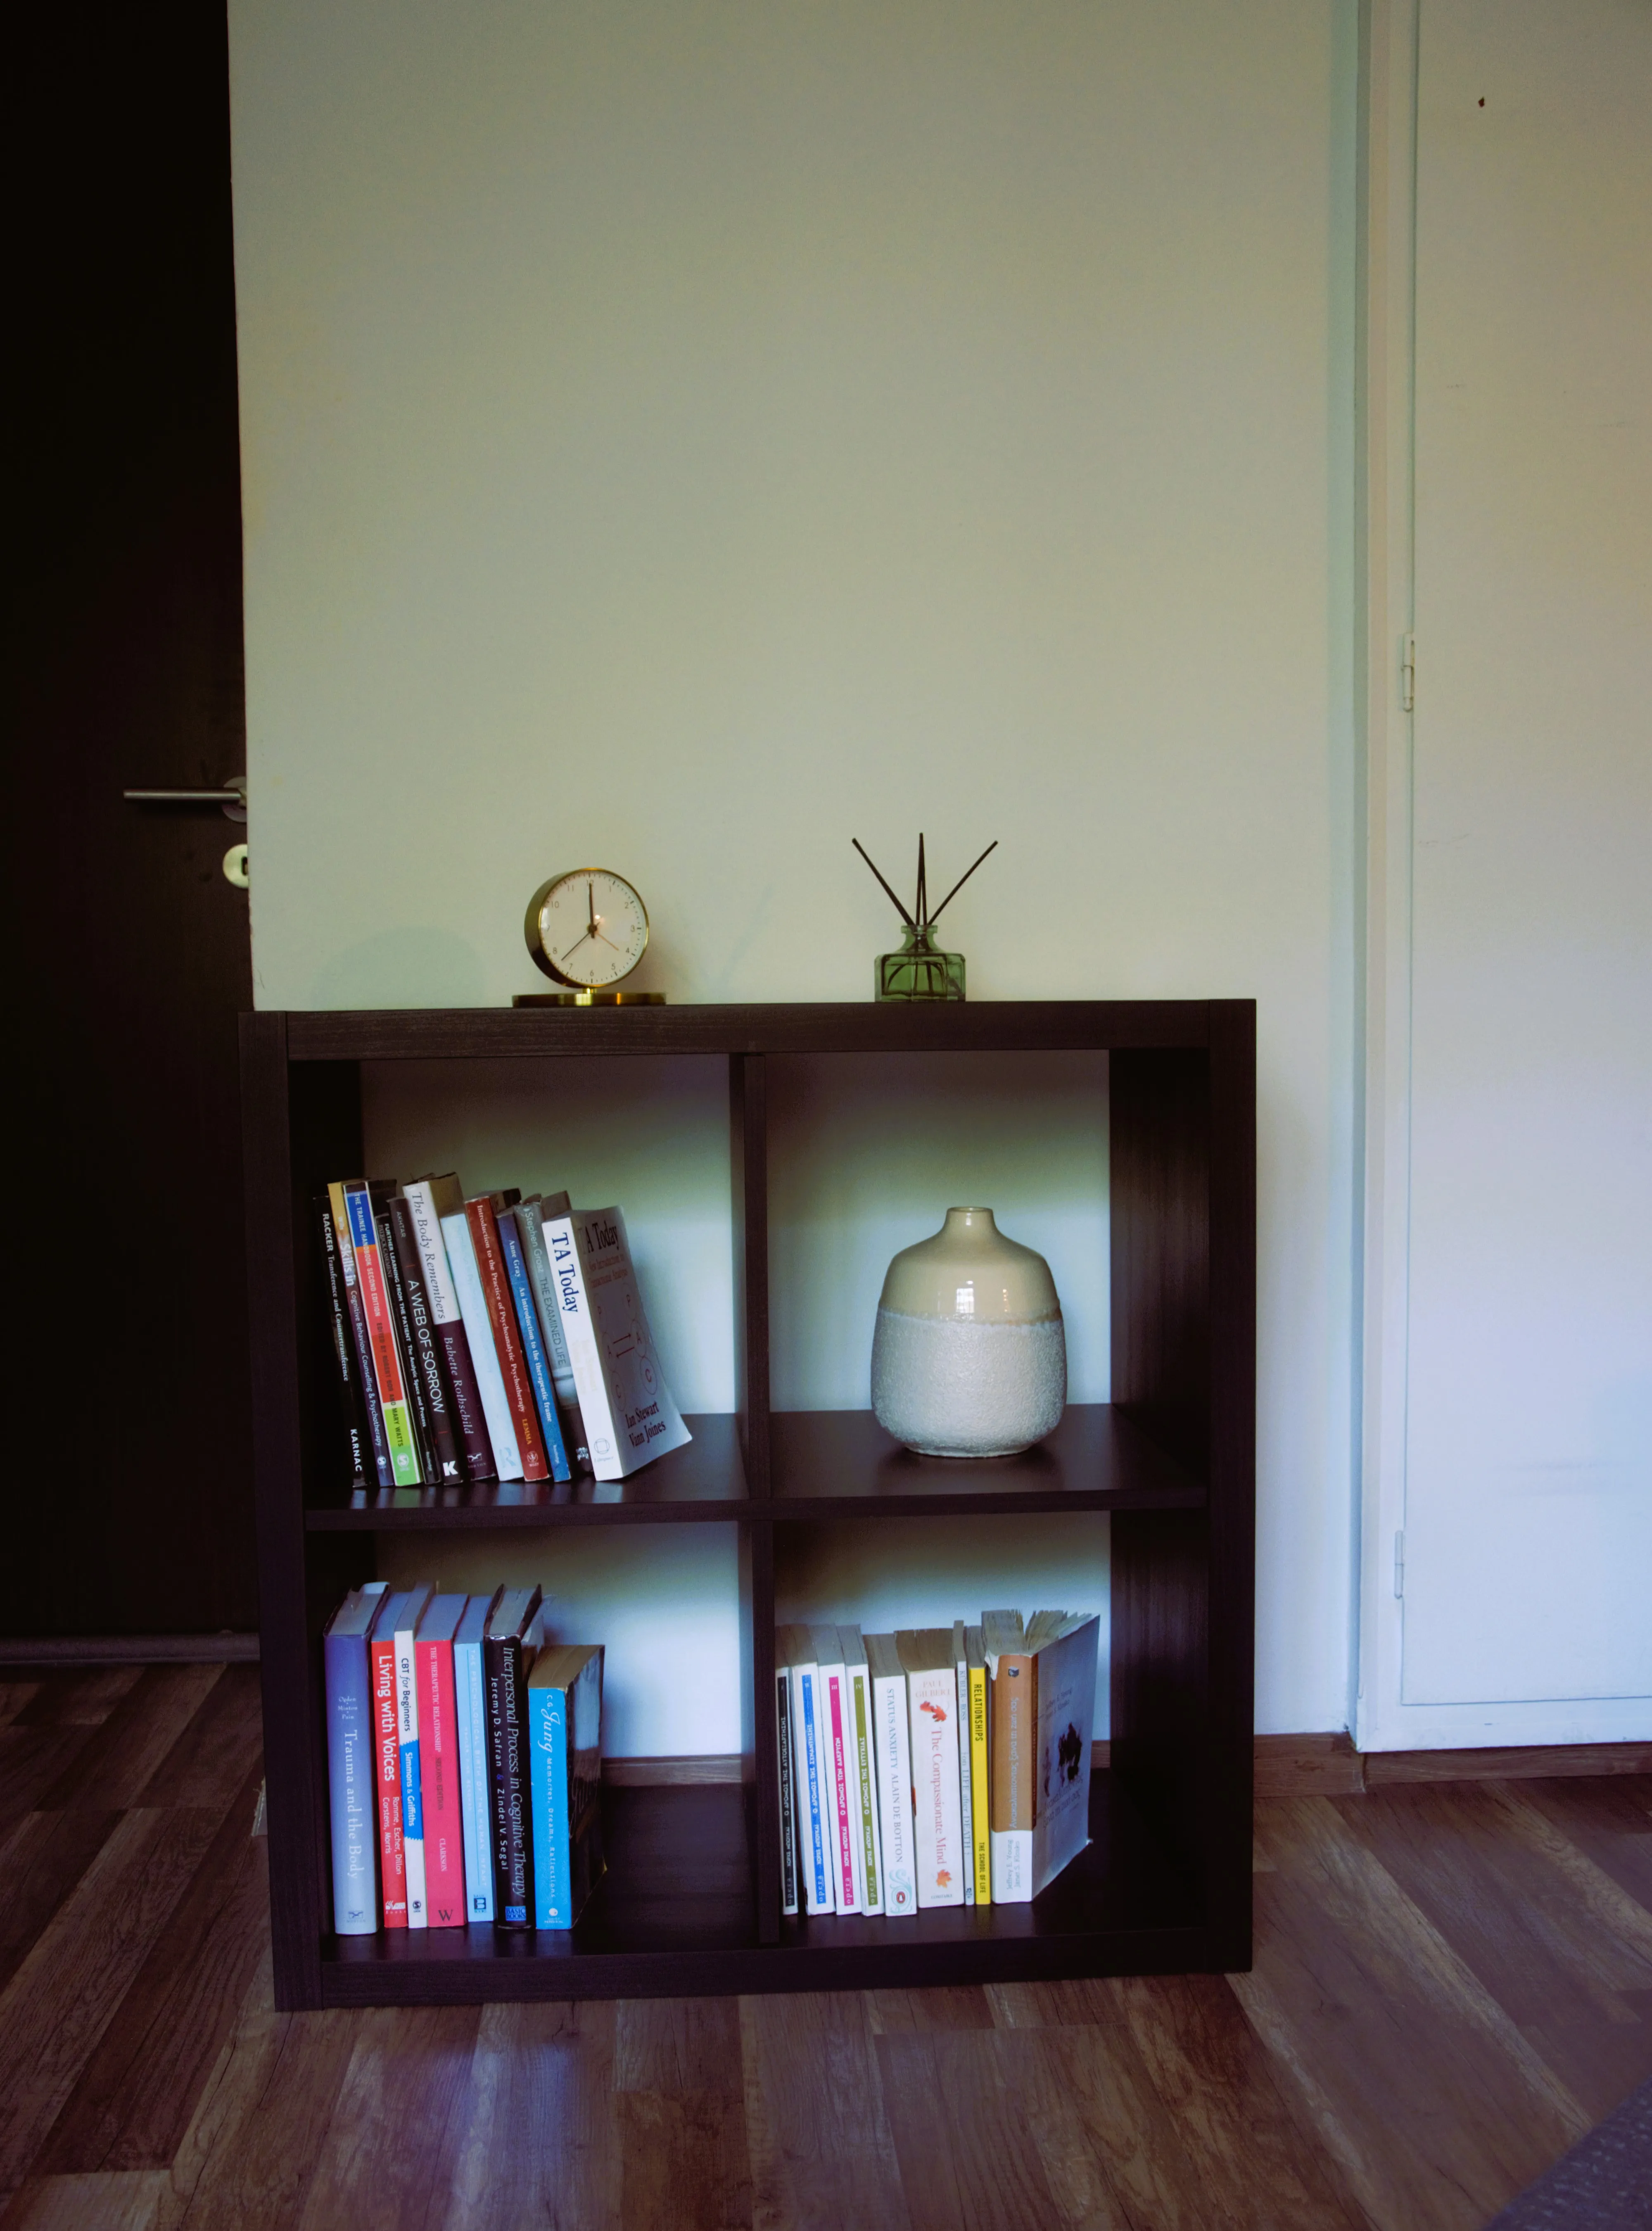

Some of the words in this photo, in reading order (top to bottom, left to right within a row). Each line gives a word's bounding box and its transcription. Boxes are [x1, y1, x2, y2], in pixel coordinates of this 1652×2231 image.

[411, 1192, 424, 1214] The
[356, 1207, 366, 1232] TRAINEE
[396, 1211, 406, 1238] AKHTAR
[417, 1219, 432, 1248] Body
[477, 1205, 491, 1249] Introduction
[591, 1220, 619, 1251] Today
[361, 1233, 372, 1266] HANDBOOK
[385, 1223, 394, 1251] FURTHER
[525, 1211, 538, 1247] Stephen
[534, 1248, 544, 1273] Grosz
[340, 1243, 355, 1273] Skills
[389, 1252, 400, 1283] LEARNING
[487, 1250, 492, 1258] to
[509, 1240, 517, 1258] Anne
[513, 1259, 521, 1278] Gray
[346, 1274, 356, 1286] in
[366, 1267, 376, 1292] SECOND
[408, 1281, 420, 1290] A
[425, 1253, 445, 1319] Remembers
[491, 1272, 501, 1301] Practice
[519, 1287, 525, 1297] An
[539, 1277, 551, 1295] THE
[558, 1264, 579, 1313] Today
[323, 1214, 333, 1251] RACKER
[328, 1255, 337, 1297] Transference
[336, 1314, 349, 1381] Countertransference
[350, 1290, 360, 1321] Cognitive
[371, 1293, 381, 1316] EDITION
[412, 1292, 427, 1326] WEB
[498, 1302, 505, 1311] of
[401, 1316, 411, 1342] PATIENT
[521, 1298, 534, 1340] introduction
[544, 1297, 561, 1345] EXAMINED
[356, 1322, 366, 1354] Behaviour
[418, 1328, 432, 1347] OF
[499, 1312, 516, 1362] Psychoanalytic
[555, 1346, 566, 1365] LIFE
[362, 1355, 373, 1392] Counselling
[376, 1322, 385, 1343] EDITED
[381, 1345, 386, 1353] BY
[395, 1426, 404, 1447] WATTS
[422, 1350, 445, 1413] SORROW
[444, 1337, 458, 1376] Babette
[453, 1380, 474, 1435] Rothschild
[510, 1363, 525, 1412] Psychotherapy
[535, 1362, 548, 1401] therapeutic
[369, 1399, 382, 1446] Psychotherapy
[544, 1402, 552, 1422] frame
[625, 1413, 636, 1429] Ian
[635, 1400, 660, 1422] Stewart
[522, 1418, 532, 1445] LEMMA
[629, 1433, 646, 1448] Vann
[643, 1421, 667, 1443] Joines
[350, 1429, 362, 1471] KARNAC
[442, 1461, 459, 1476] K
[377, 1655, 393, 1698] Living
[400, 1675, 411, 1689] for
[401, 1658, 409, 1674] CBT
[430, 1661, 439, 1705] THERAPEUTIC
[501, 1647, 519, 1724] Interpersonal
[915, 1689, 951, 1698] GILBERT
[923, 1680, 942, 1688] PAUL
[381, 1700, 396, 1733] with
[401, 1690, 411, 1732] Beginners
[886, 1688, 895, 1724] STATUS
[974, 1684, 984, 1742] RELATIONSHIPS
[433, 1706, 441, 1752] RELATIONSHIP
[494, 1718, 501, 1727] D.
[538, 1708, 561, 1753] Jung
[494, 1731, 503, 1767] Safran
[508, 1728, 519, 1773] Process
[889, 1725, 898, 1769] ANXIETY
[930, 1727, 942, 1751] The
[344, 1729, 358, 1783] Trauma
[382, 1736, 397, 1782] Voices
[405, 1752, 413, 1787] Simmons
[510, 1777, 522, 1789] in
[891, 1773, 901, 1803] ALAIN
[930, 1753, 945, 1834] Compassionate
[347, 1788, 362, 1813] and
[382, 1797, 391, 1830] Corstens,
[407, 1795, 416, 1827] Griffiths
[497, 1788, 506, 1824] Zindel
[892, 1806, 901, 1820] DE
[347, 1818, 363, 1839] the
[499, 1827, 507, 1836] V.
[508, 1793, 525, 1848] Cognitive
[394, 1827, 402, 1852] Escher,
[439, 1838, 448, 1872] CLARKSON
[499, 1840, 508, 1870] Segal
[893, 1822, 903, 1863] BOTTON
[936, 1837, 947, 1865] Mind
[347, 1845, 366, 1879] Body
[395, 1854, 404, 1875] Dillon
[512, 1851, 527, 1898] Therapy
[438, 1910, 453, 1922] W
